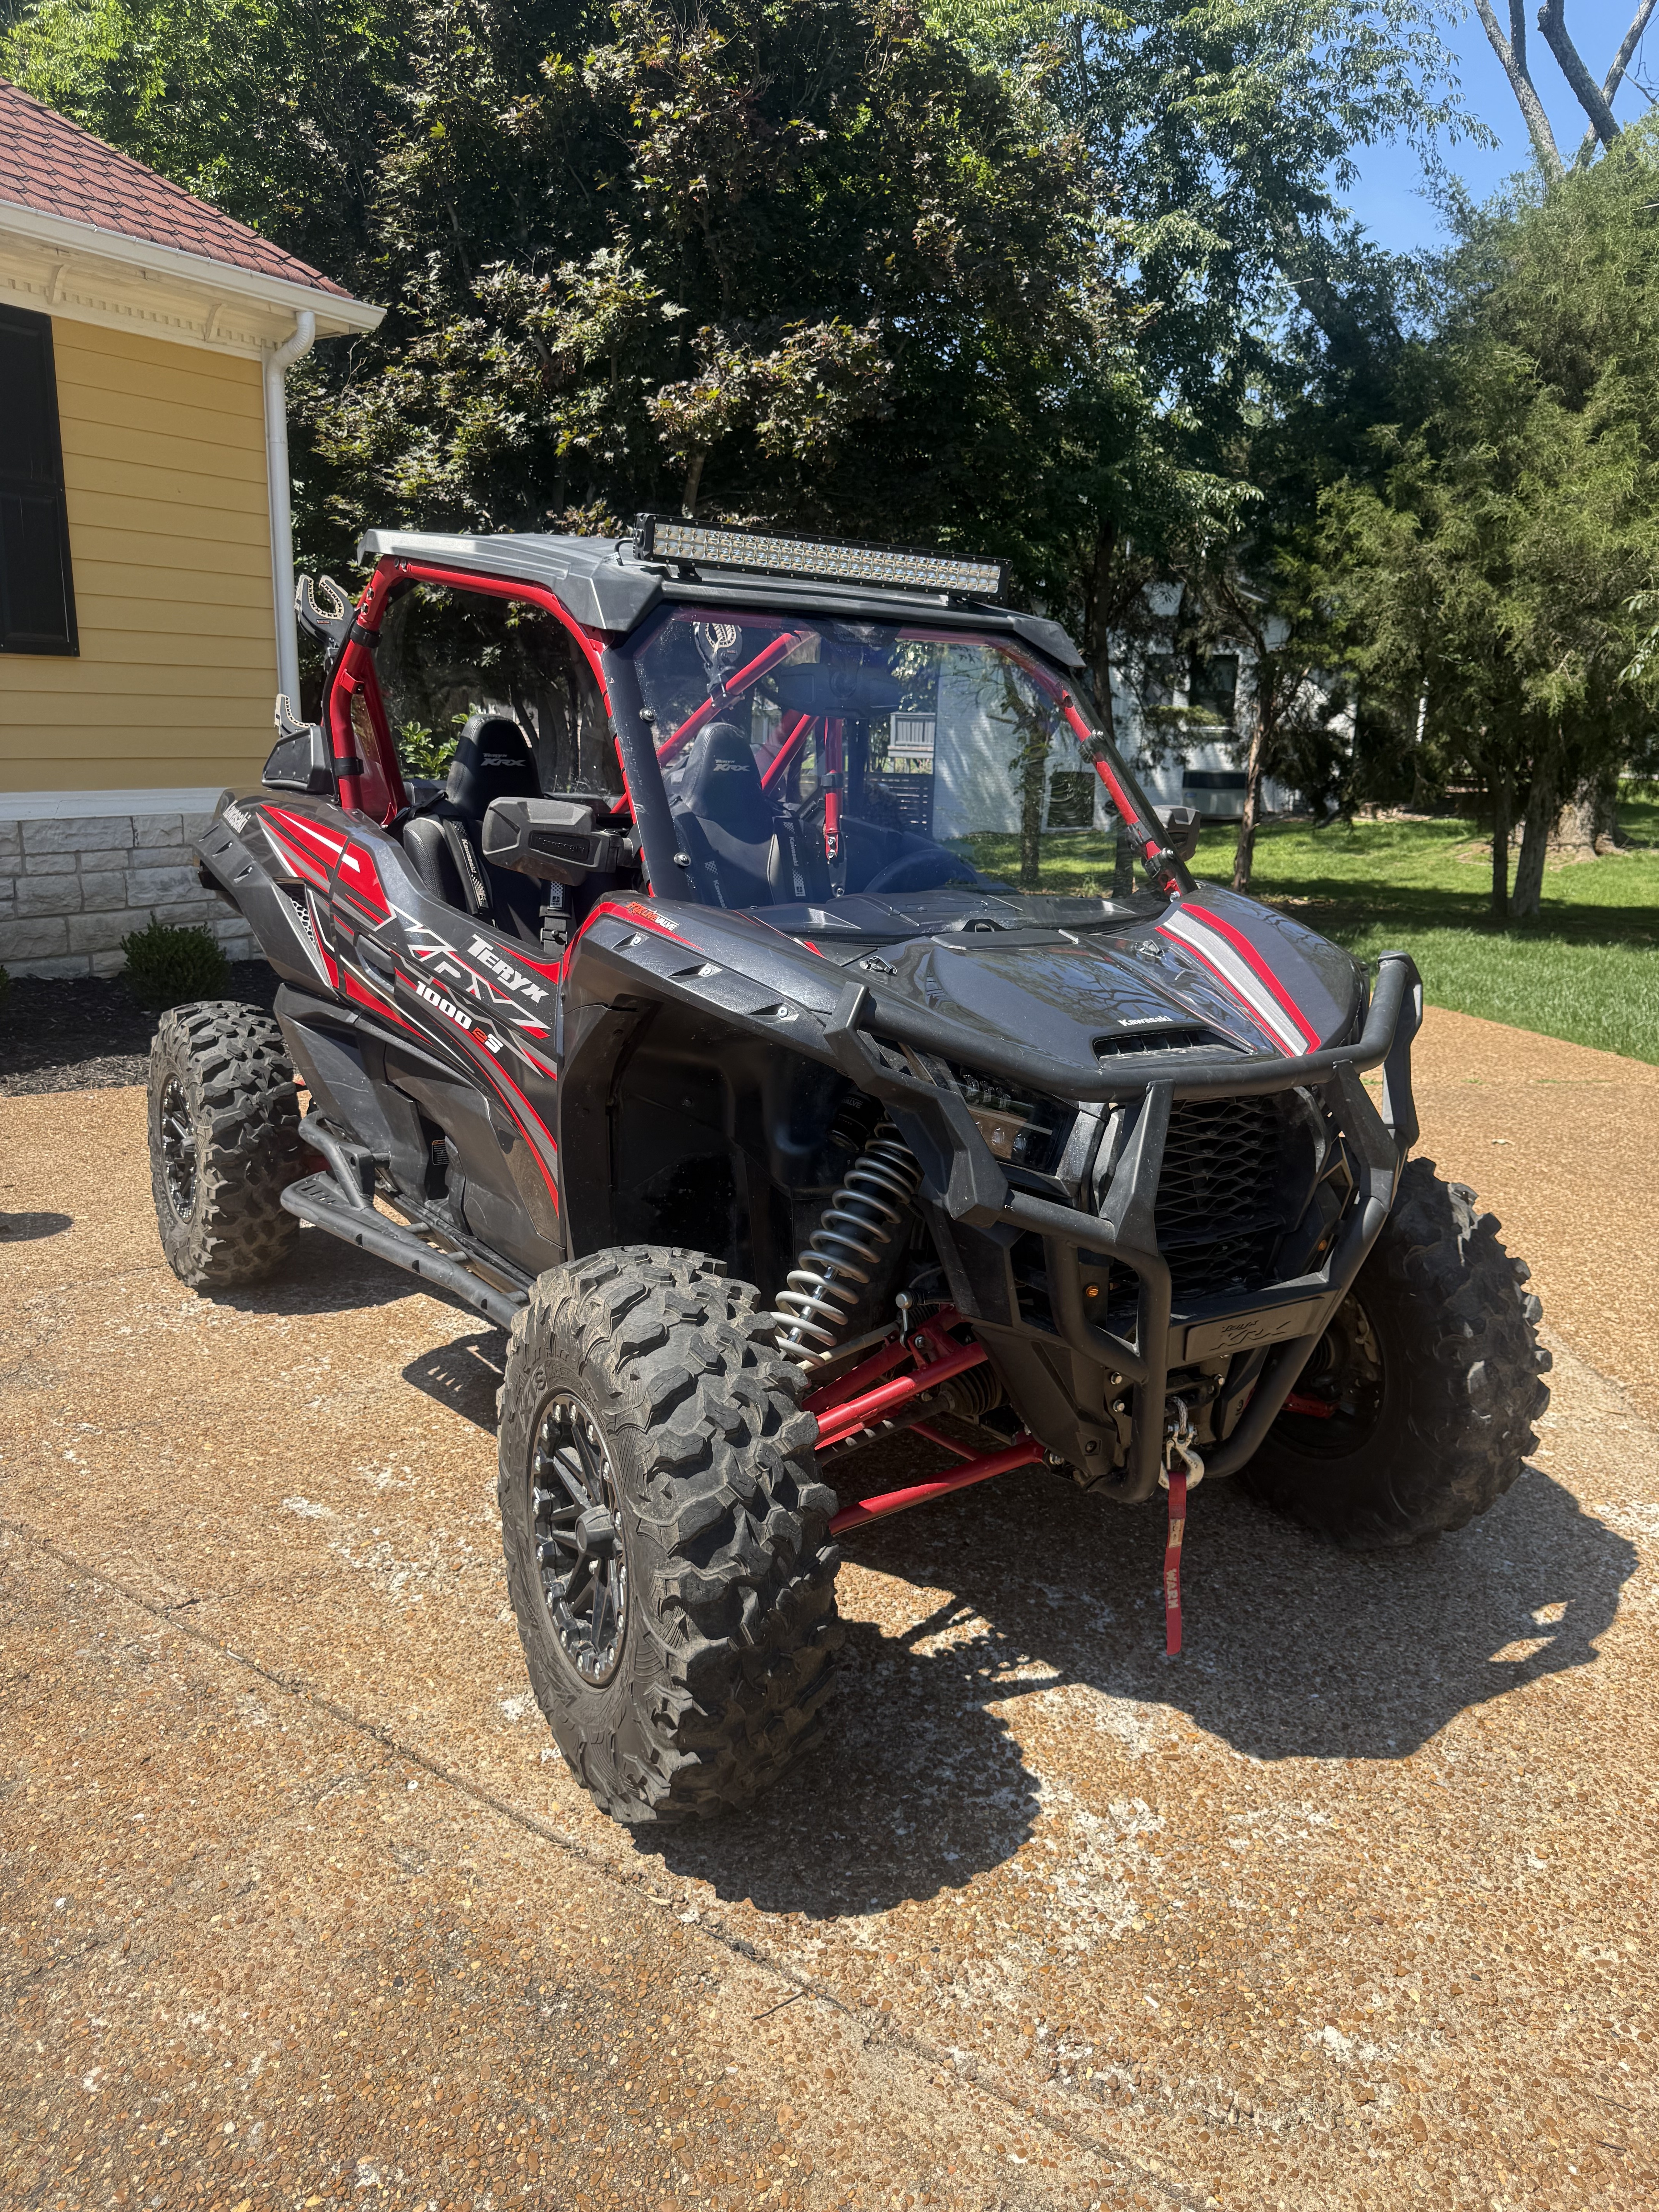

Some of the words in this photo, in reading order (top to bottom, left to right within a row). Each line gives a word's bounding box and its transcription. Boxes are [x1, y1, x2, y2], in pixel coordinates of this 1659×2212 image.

[481, 758, 526, 767] KRX
[223, 799, 251, 834] Kawasaki
[461, 839, 477, 873] Kawasaki
[789, 836, 799, 866] Kawasaki
[415, 980, 472, 1030] 1000
[1118, 1015, 1173, 1027] Kawasaki
[1209, 1320, 1291, 1351] KRX
[1165, 1568, 1179, 1609] WARN
